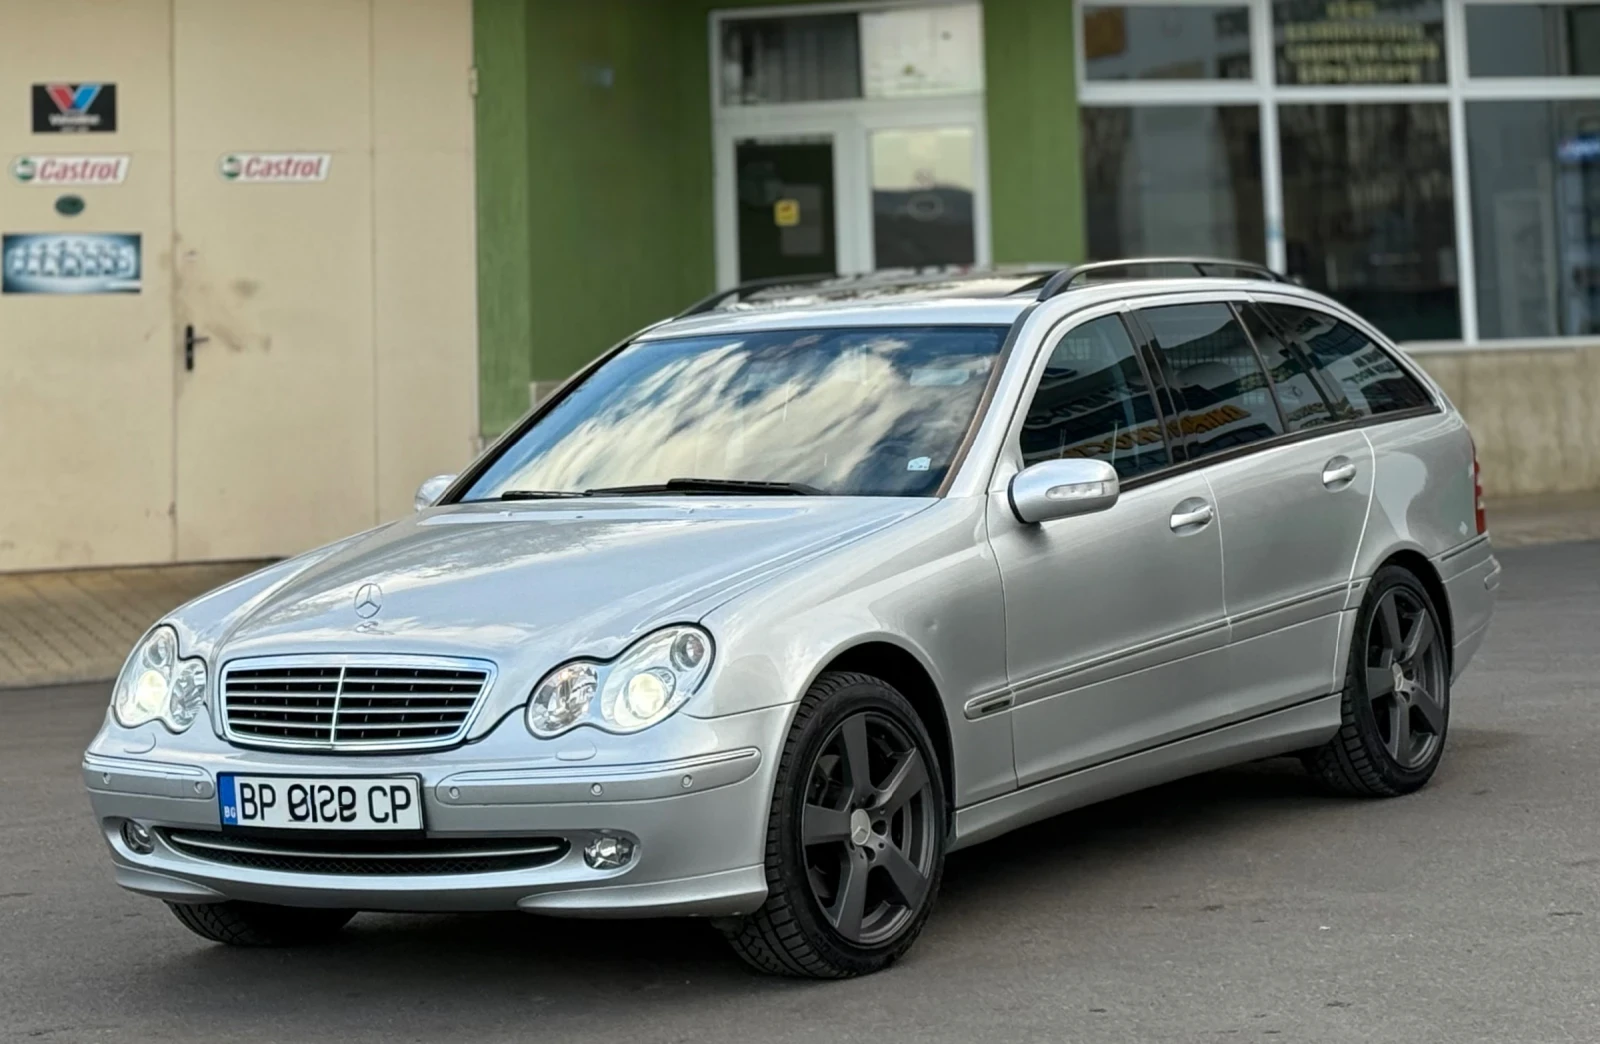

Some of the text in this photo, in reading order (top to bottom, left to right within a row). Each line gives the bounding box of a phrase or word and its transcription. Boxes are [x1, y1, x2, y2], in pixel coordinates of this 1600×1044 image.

[39, 158, 121, 181] Castrol
[245, 156, 323, 179] Castrol
[224, 806, 236, 818] BG
[239, 782, 276, 821] BP
[367, 785, 411, 824] CP
